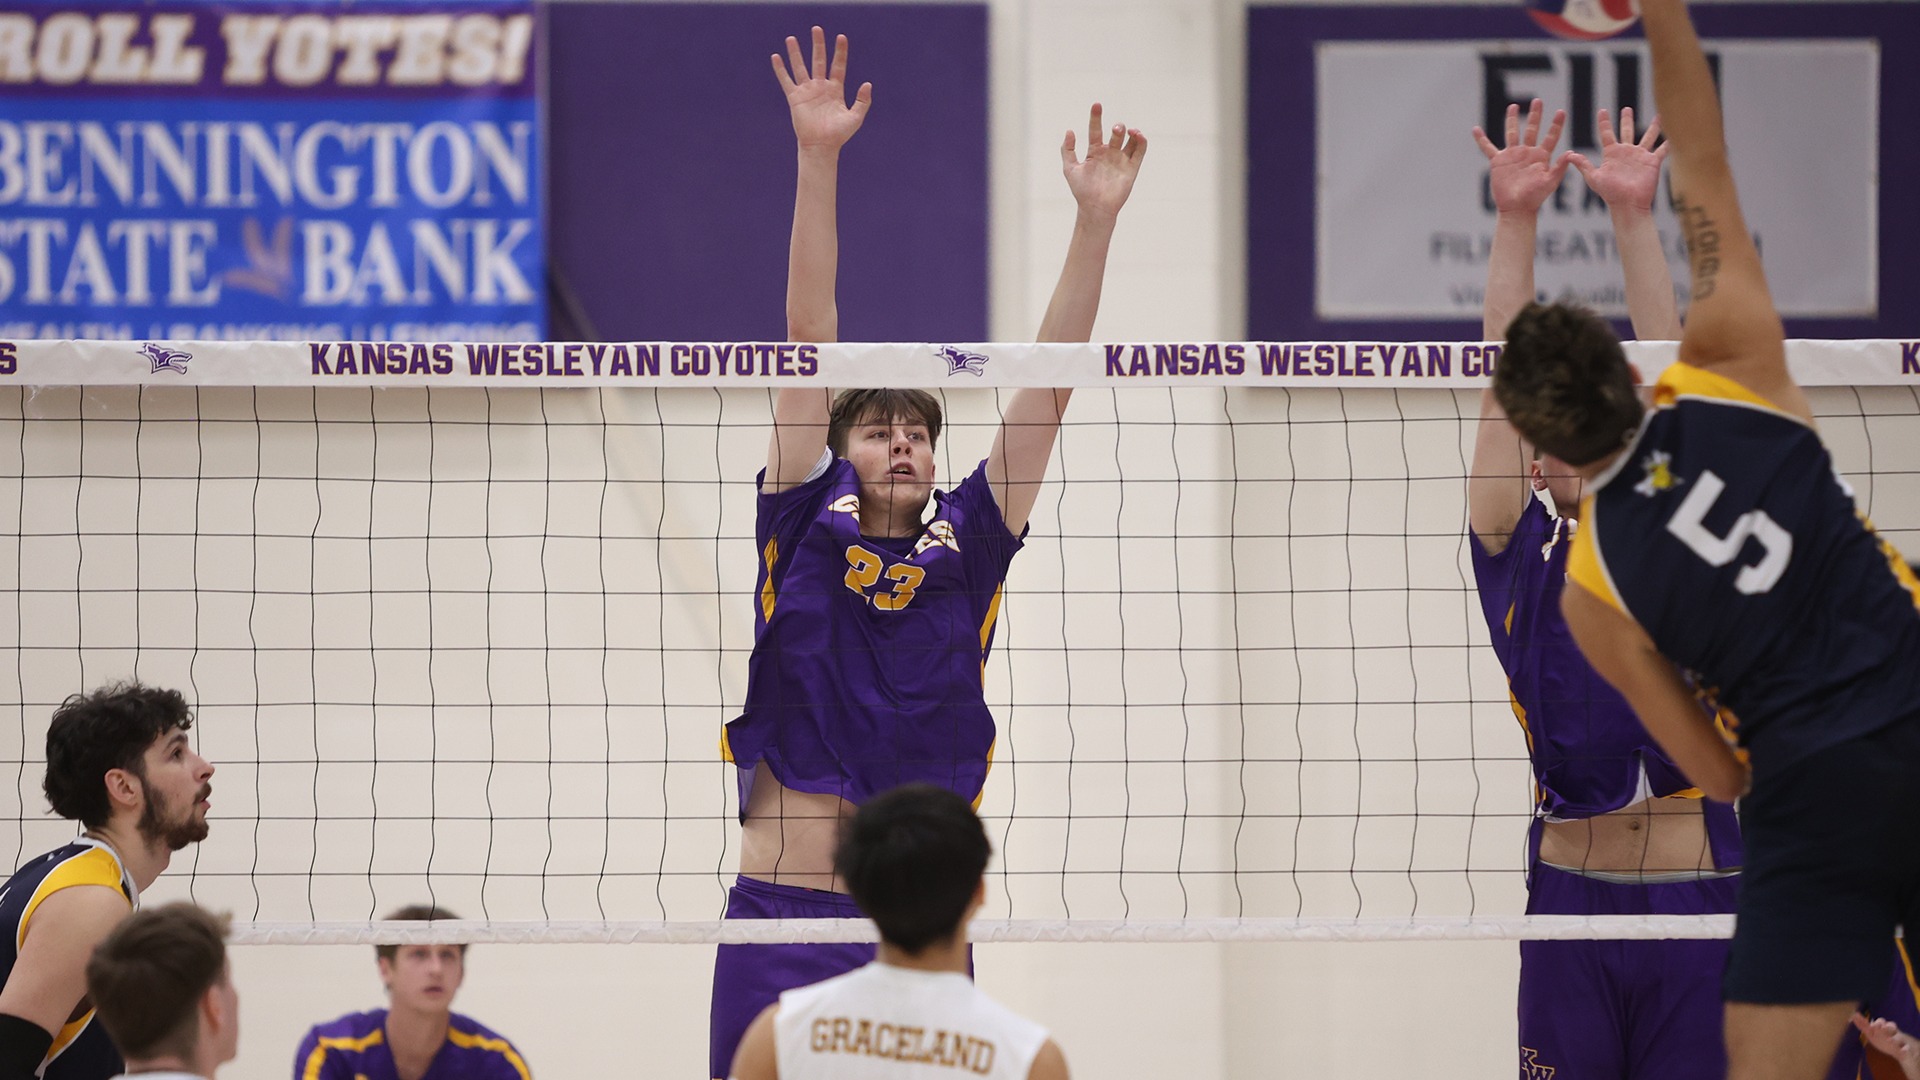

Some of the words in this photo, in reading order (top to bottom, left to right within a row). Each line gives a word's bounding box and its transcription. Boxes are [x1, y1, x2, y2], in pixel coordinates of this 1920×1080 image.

[221, 13, 533, 87] YOTES!
[303, 218, 537, 307] BANK
[310, 343, 453, 376] KANSAS
[467, 343, 660, 377] WESLEYAN
[670, 343, 818, 377] COYOTES
[1105, 344, 1245, 377] KANSAS
[1256, 344, 1451, 377] WESLEYAN
[1667, 470, 1793, 595] 5
[844, 544, 926, 611] 23
[810, 1017, 996, 1076] GRACELAND
